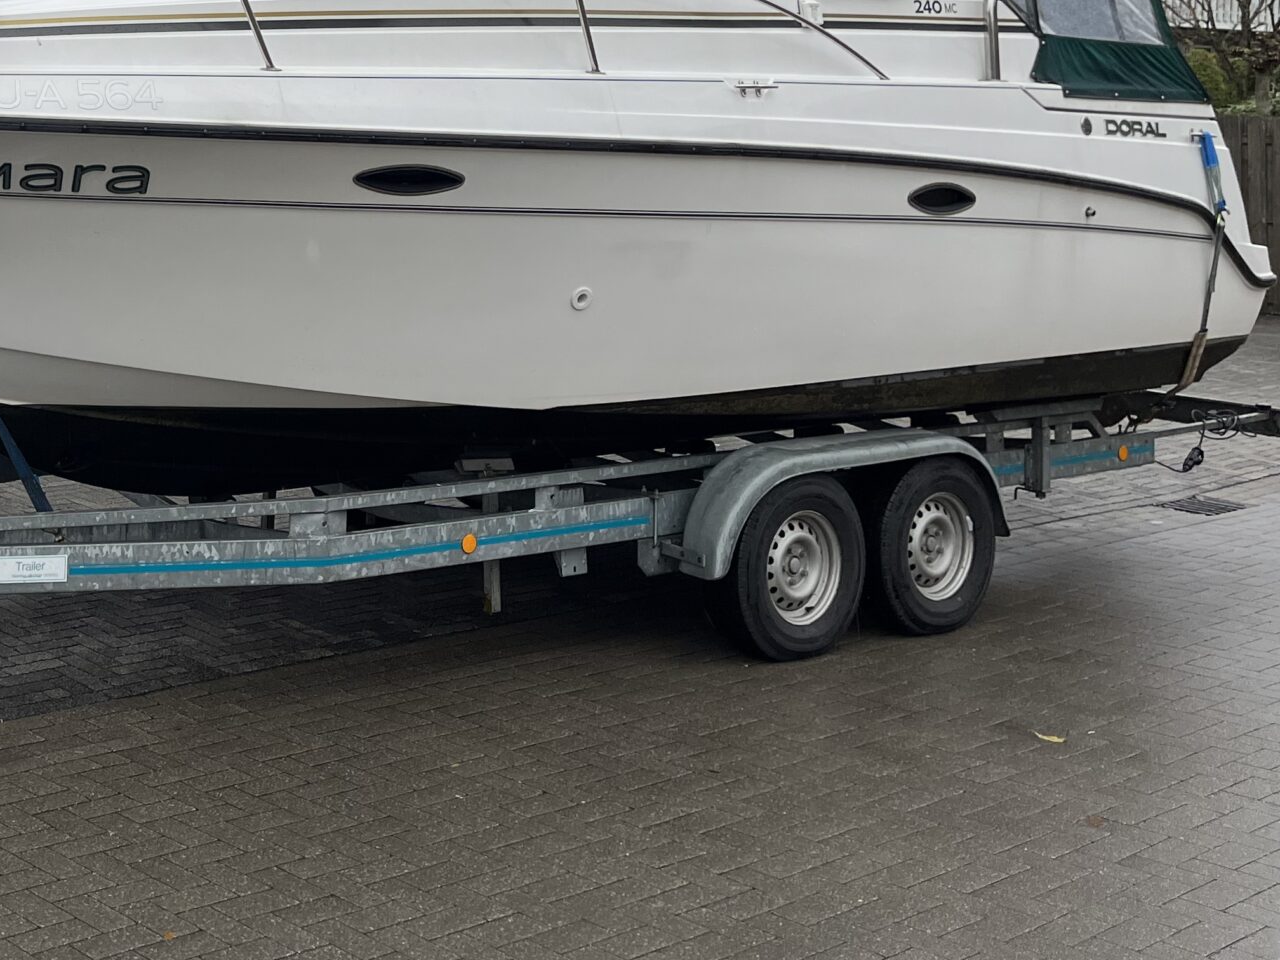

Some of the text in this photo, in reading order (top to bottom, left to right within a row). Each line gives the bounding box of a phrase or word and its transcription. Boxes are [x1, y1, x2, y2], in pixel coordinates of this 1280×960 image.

[913, 0, 958, 14] 240 MC
[76, 79, 164, 111] 564
[1104, 119, 1167, 138] DORAL
[16, 561, 46, 572] Trailer
